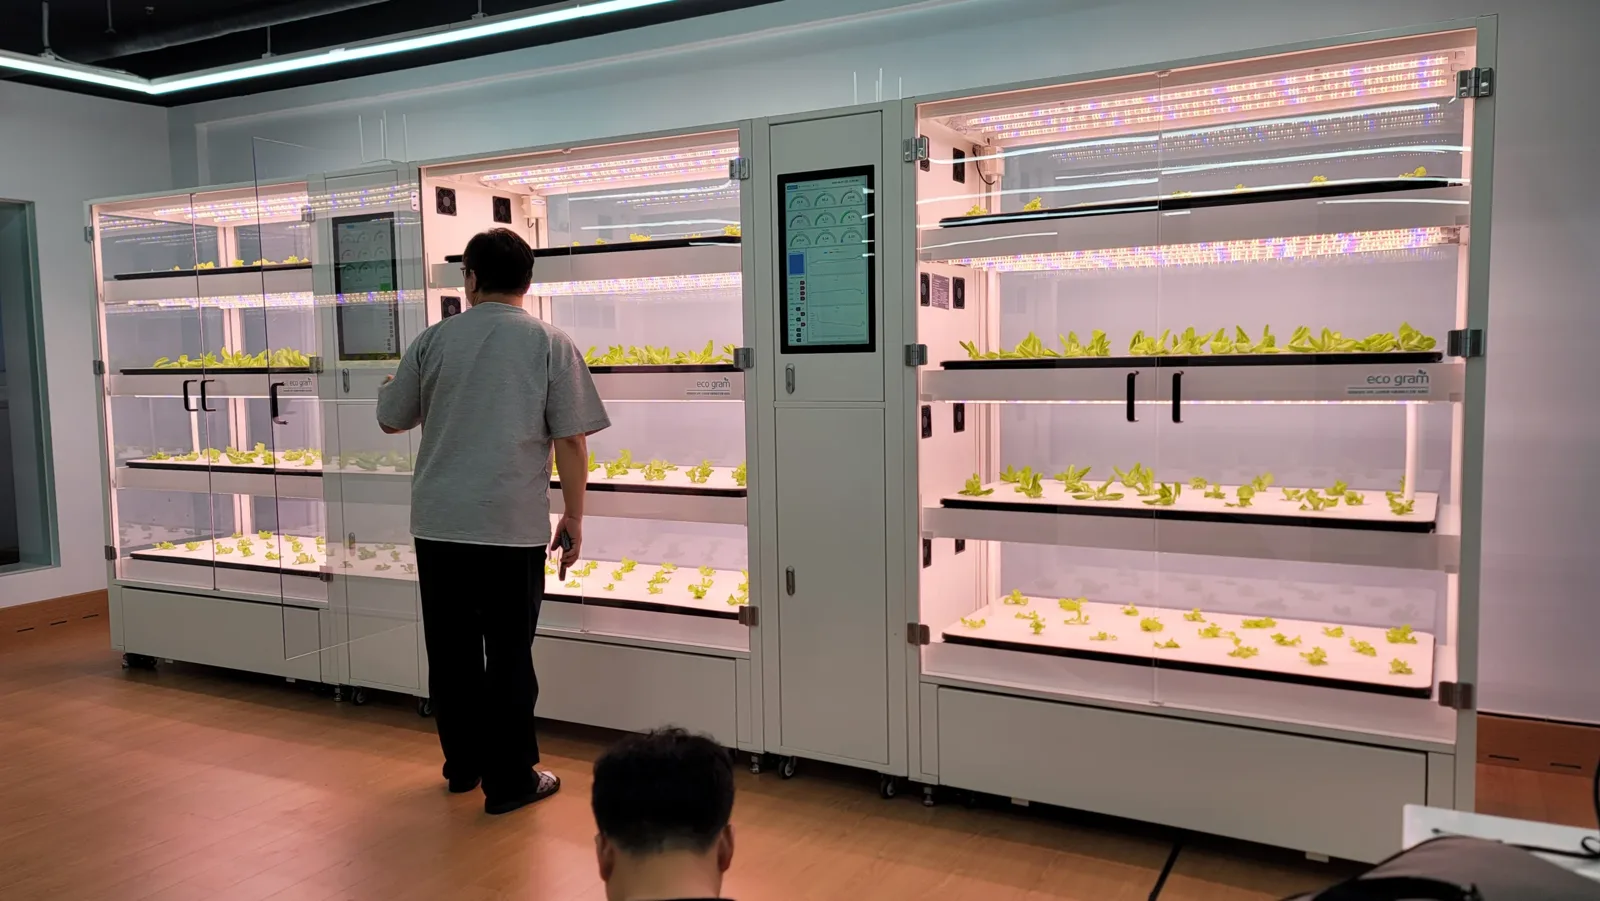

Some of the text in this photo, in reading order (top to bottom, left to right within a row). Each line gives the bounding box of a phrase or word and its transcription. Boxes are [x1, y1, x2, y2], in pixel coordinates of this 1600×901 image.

[711, 381, 730, 389] gram
[1367, 375, 1429, 386] eco gram
